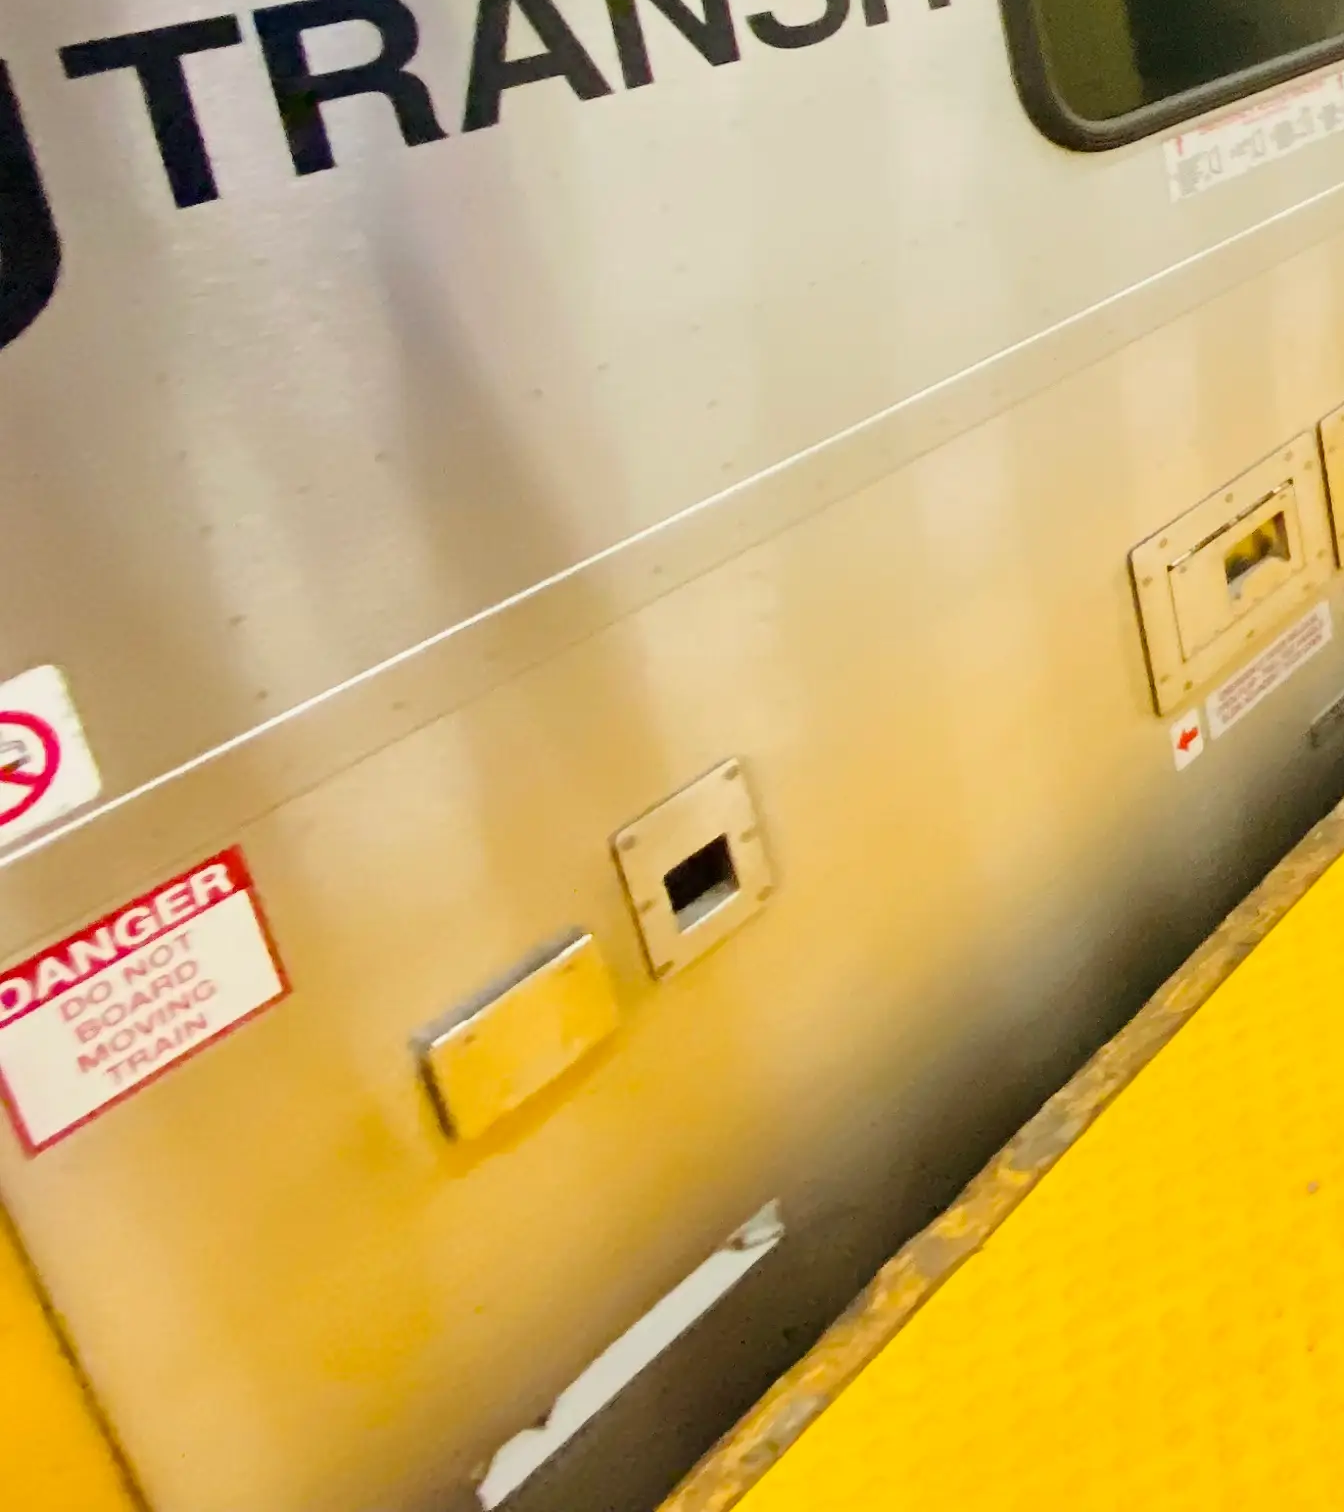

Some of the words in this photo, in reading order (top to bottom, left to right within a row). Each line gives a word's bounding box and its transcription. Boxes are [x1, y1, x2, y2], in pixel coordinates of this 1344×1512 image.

[0, 863, 236, 1015] DANGER
[58, 979, 113, 1022] DO
[122, 928, 193, 985] NOT
[74, 959, 198, 1044] BOARD
[76, 978, 219, 1073] MOVING
[104, 1010, 209, 1085] TRAIN
